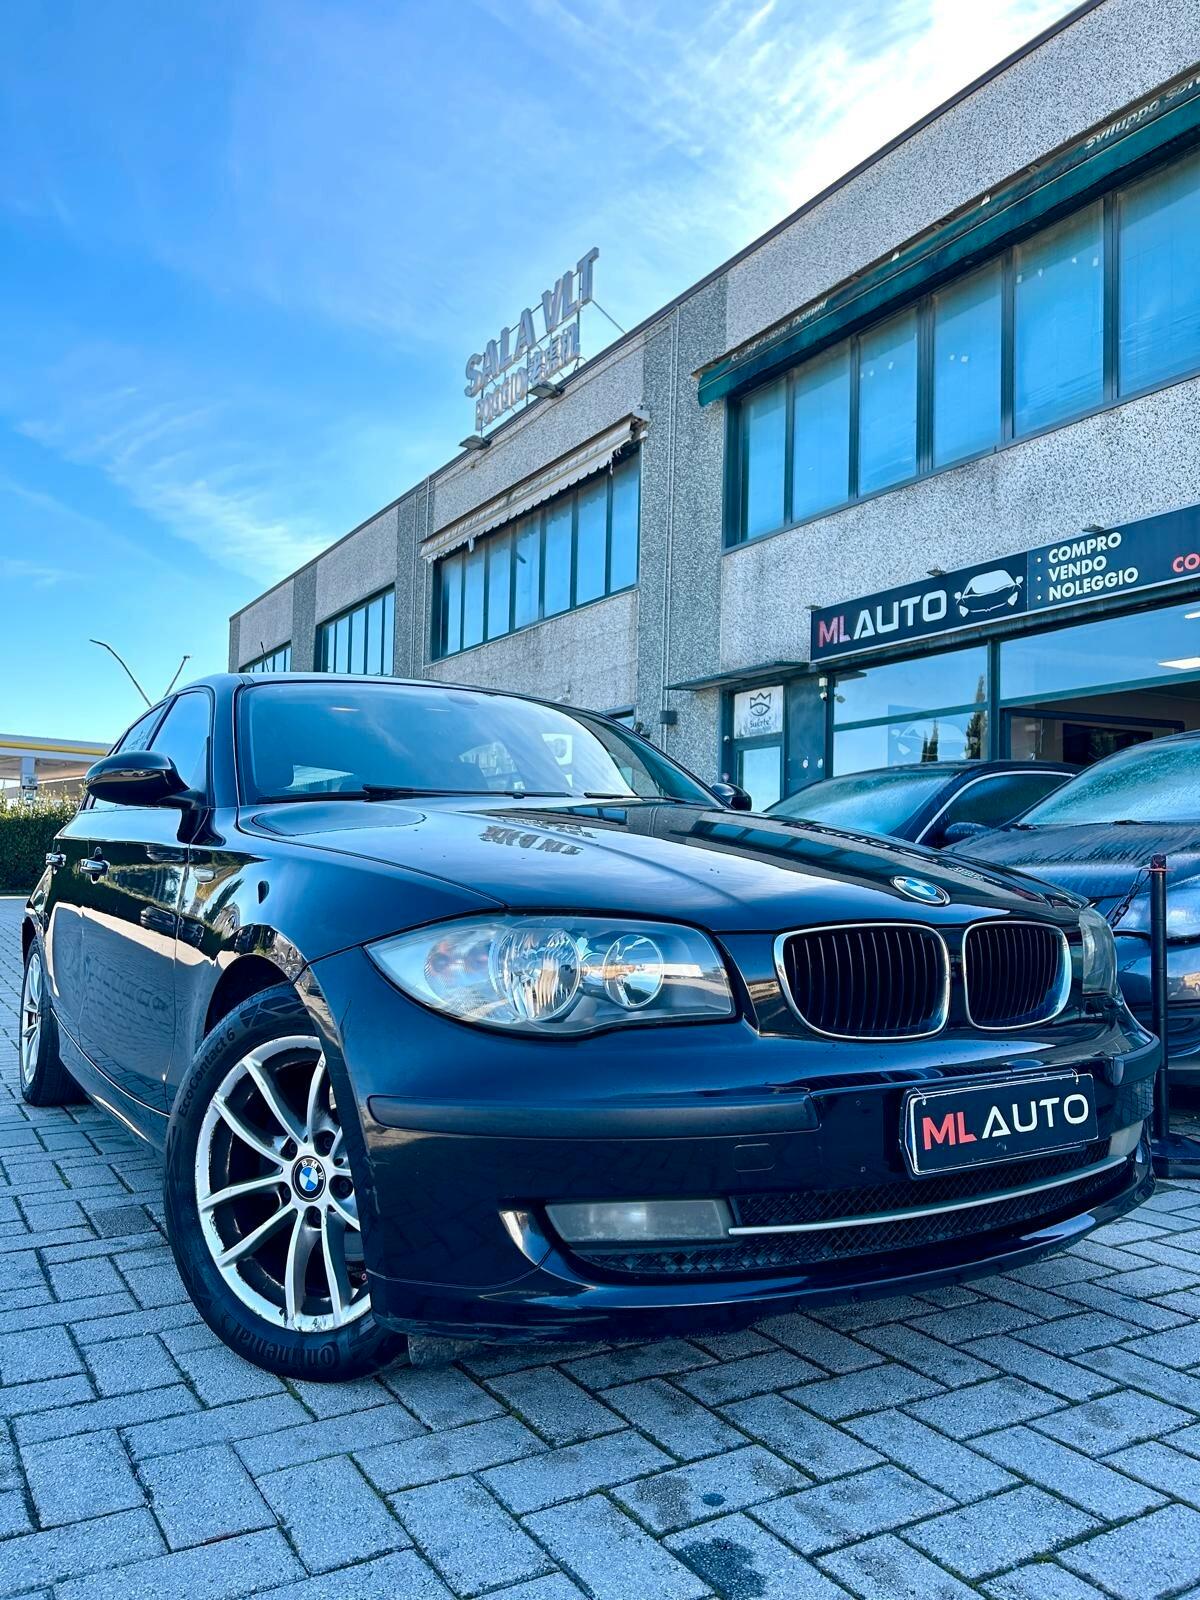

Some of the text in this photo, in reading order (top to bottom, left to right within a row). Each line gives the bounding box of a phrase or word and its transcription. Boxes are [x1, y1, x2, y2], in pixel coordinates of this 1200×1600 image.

[1084, 99, 1161, 150] Sviluppo
[464, 308, 536, 398] SALA
[541, 247, 600, 334] VLT
[1048, 532, 1122, 564] COMPRO
[1048, 555, 1107, 582] VENDO
[1172, 552, 1200, 573] CO
[1048, 567, 1139, 601] NOLEGGIO
[818, 589, 947, 648] ML AUTO
[178, 1027, 236, 1118] EcoContact 6
[922, 1094, 1089, 1150] ML AUTO
[301, 1160, 325, 1180] BMW
